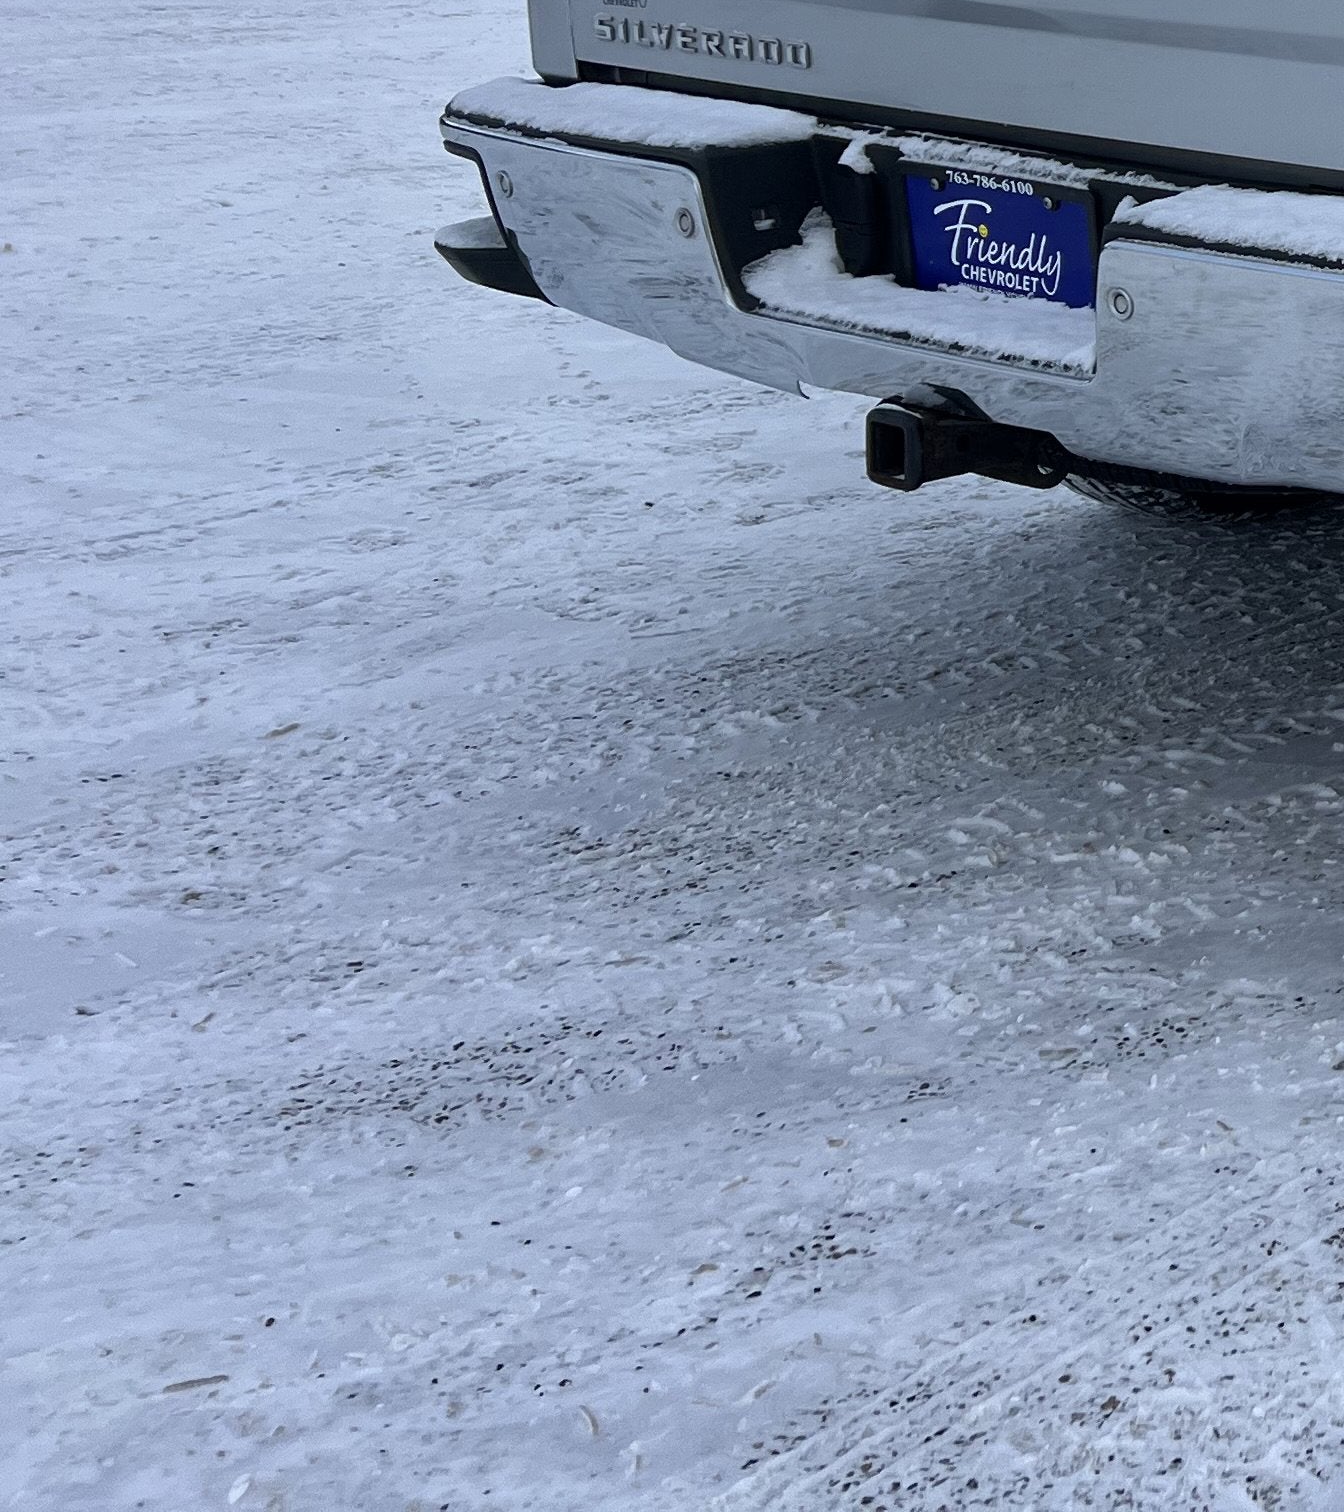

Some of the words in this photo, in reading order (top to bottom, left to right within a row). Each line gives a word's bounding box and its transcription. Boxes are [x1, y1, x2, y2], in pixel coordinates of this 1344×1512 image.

[594, 12, 812, 70] SILVERADO
[945, 170, 1034, 196] 763-786-6100
[933, 199, 1062, 296] Friendly
[961, 263, 1040, 293] CHEVROLET
